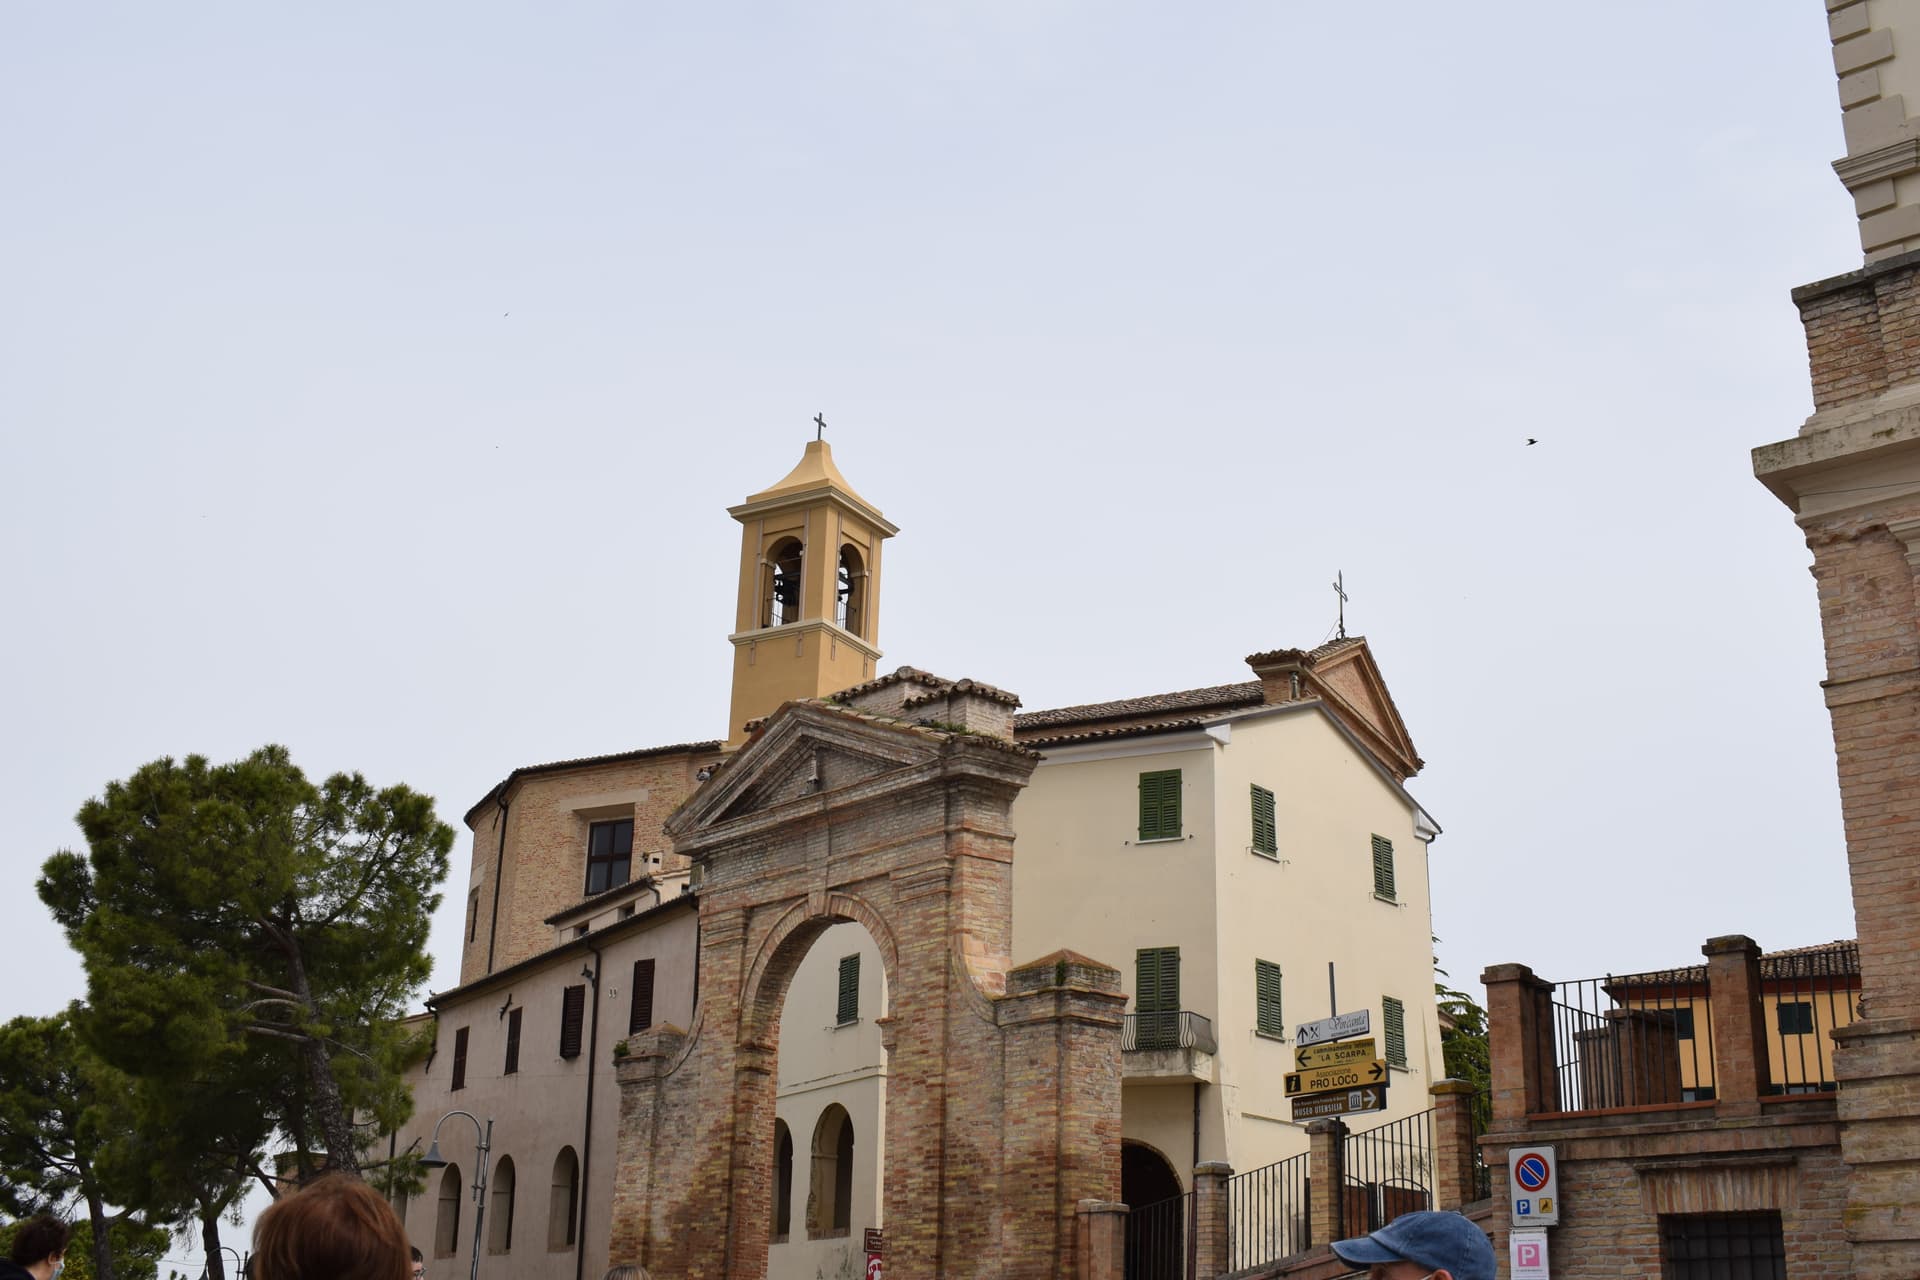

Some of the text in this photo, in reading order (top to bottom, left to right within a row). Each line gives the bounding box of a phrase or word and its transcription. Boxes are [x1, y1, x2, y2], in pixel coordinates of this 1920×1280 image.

[1315, 1067, 1352, 1078] Associazione
[1310, 1073, 1359, 1090] PRO LOCO
[1294, 1103, 1343, 1117] MUSEO UTENSILIA
[1520, 1201, 1528, 1214] P
[1521, 1245, 1536, 1265] P
